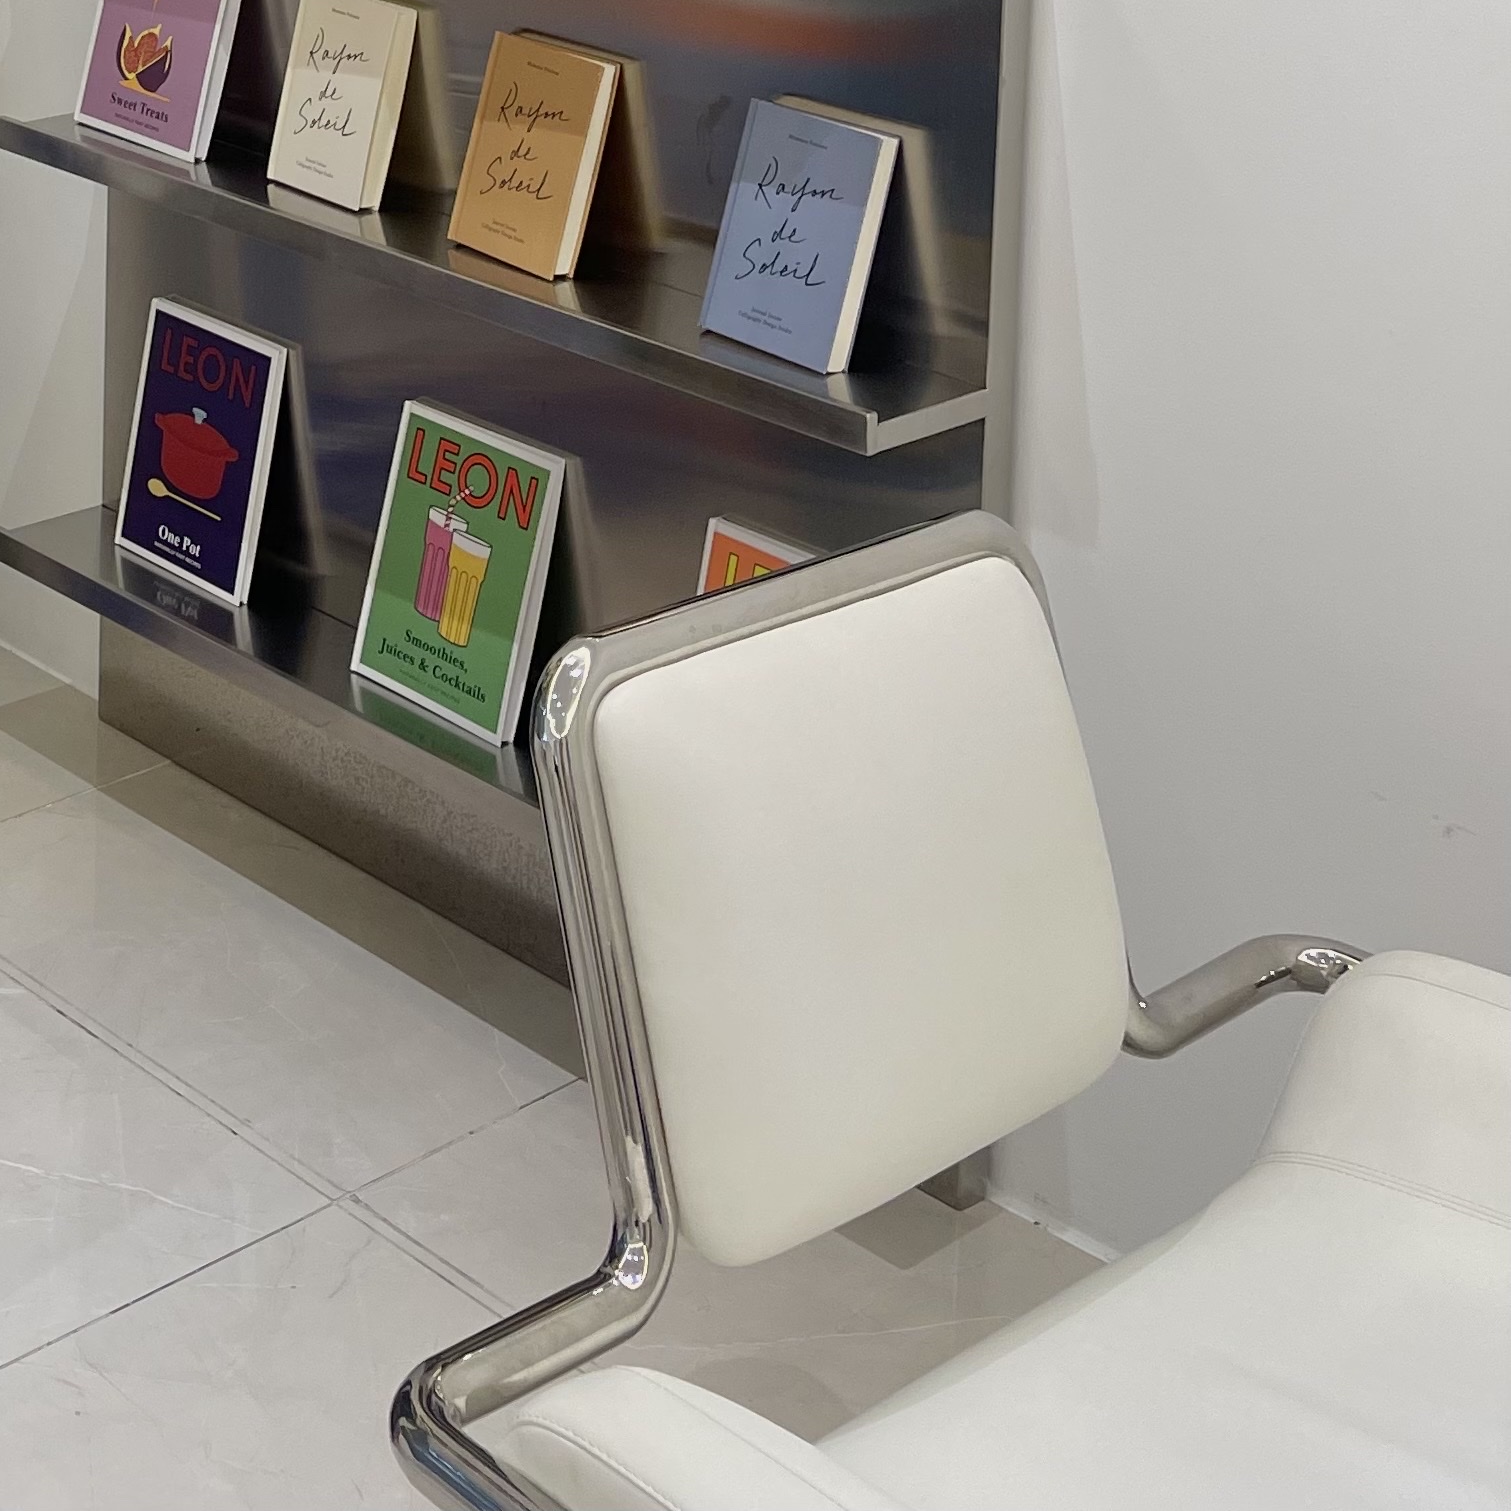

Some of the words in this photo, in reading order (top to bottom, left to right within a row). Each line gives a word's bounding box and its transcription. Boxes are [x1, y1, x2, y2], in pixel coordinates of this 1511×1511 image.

[307, 27, 370, 73] Rayon
[110, 91, 137, 111] Sweet
[140, 102, 169, 123] Treats
[317, 79, 343, 101] de
[496, 81, 570, 133] Rayon
[293, 98, 357, 136] Soleil
[509, 138, 540, 161] de
[479, 156, 554, 200] Soleil
[754, 156, 844, 212] Rayon
[770, 219, 808, 245] de
[734, 237, 828, 287] Soleil
[161, 327, 257, 408] LEON
[406, 427, 539, 530] LEON
[158, 524, 180, 547] One
[182, 536, 201, 557] Pot
[378, 637, 416, 666] Juices
[418, 657, 429, 673] &
[432, 665, 486, 704] Cocktails
[404, 629, 468, 674] Smoothies,
